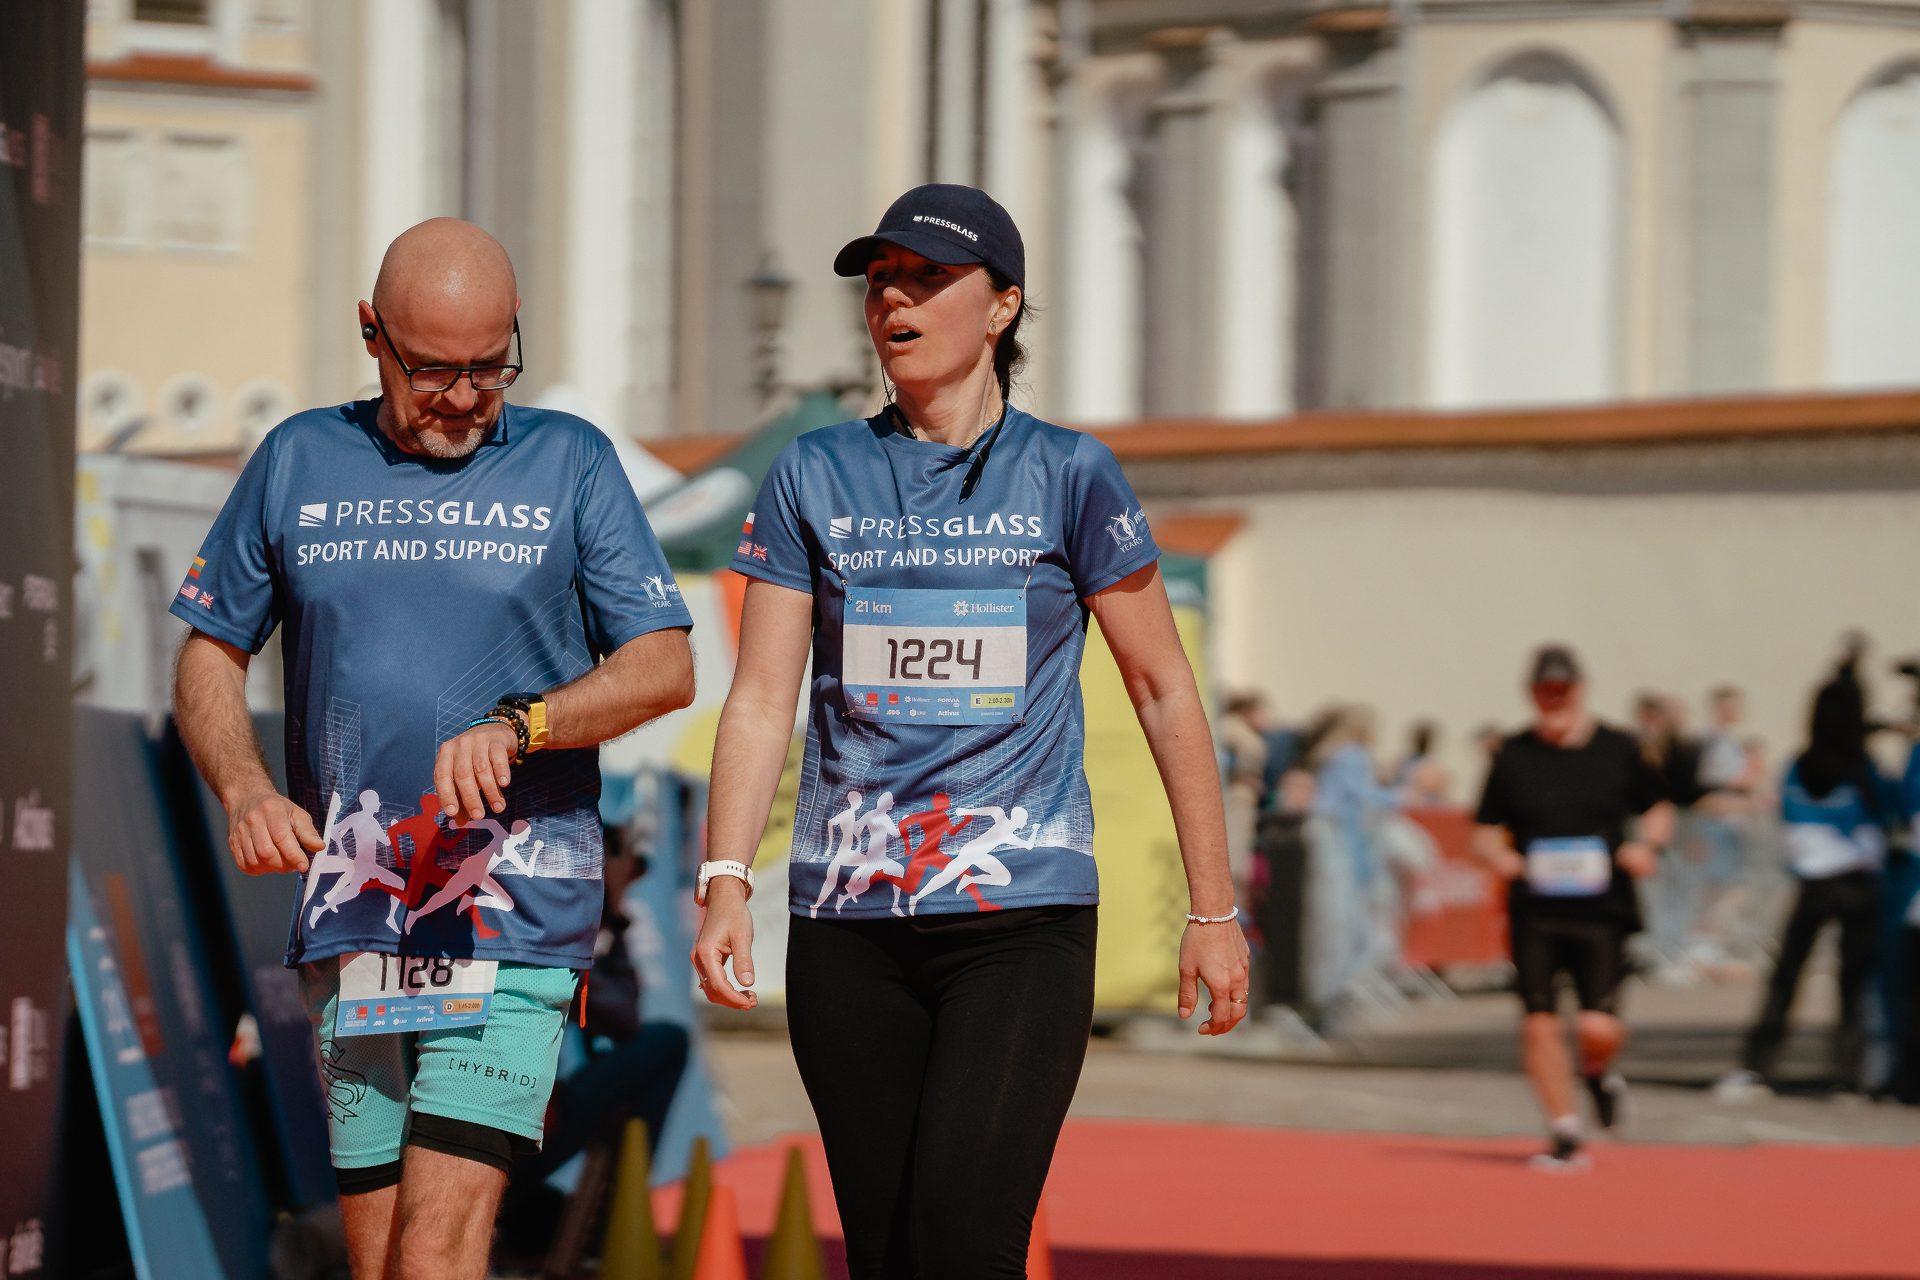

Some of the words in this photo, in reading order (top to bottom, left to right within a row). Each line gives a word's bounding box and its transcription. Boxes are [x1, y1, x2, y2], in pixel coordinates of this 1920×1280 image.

[923, 215, 979, 242] PRESSGLASS
[336, 499, 551, 531] PRESSGLASS
[859, 513, 1042, 538] PRESSGLASS
[297, 540, 368, 566] SPORT
[373, 540, 428, 561] AND
[434, 540, 548, 565] SUPPORT
[1119, 536, 1143, 553] YEARS
[827, 549, 887, 571] SPORT
[890, 548, 938, 567] AND
[944, 547, 1044, 567] SUPPORT
[652, 600, 672, 608] YEARS
[855, 600, 869, 613] 21
[872, 602, 892, 614] km
[971, 603, 1015, 613] Hollister
[887, 638, 983, 680] 1224
